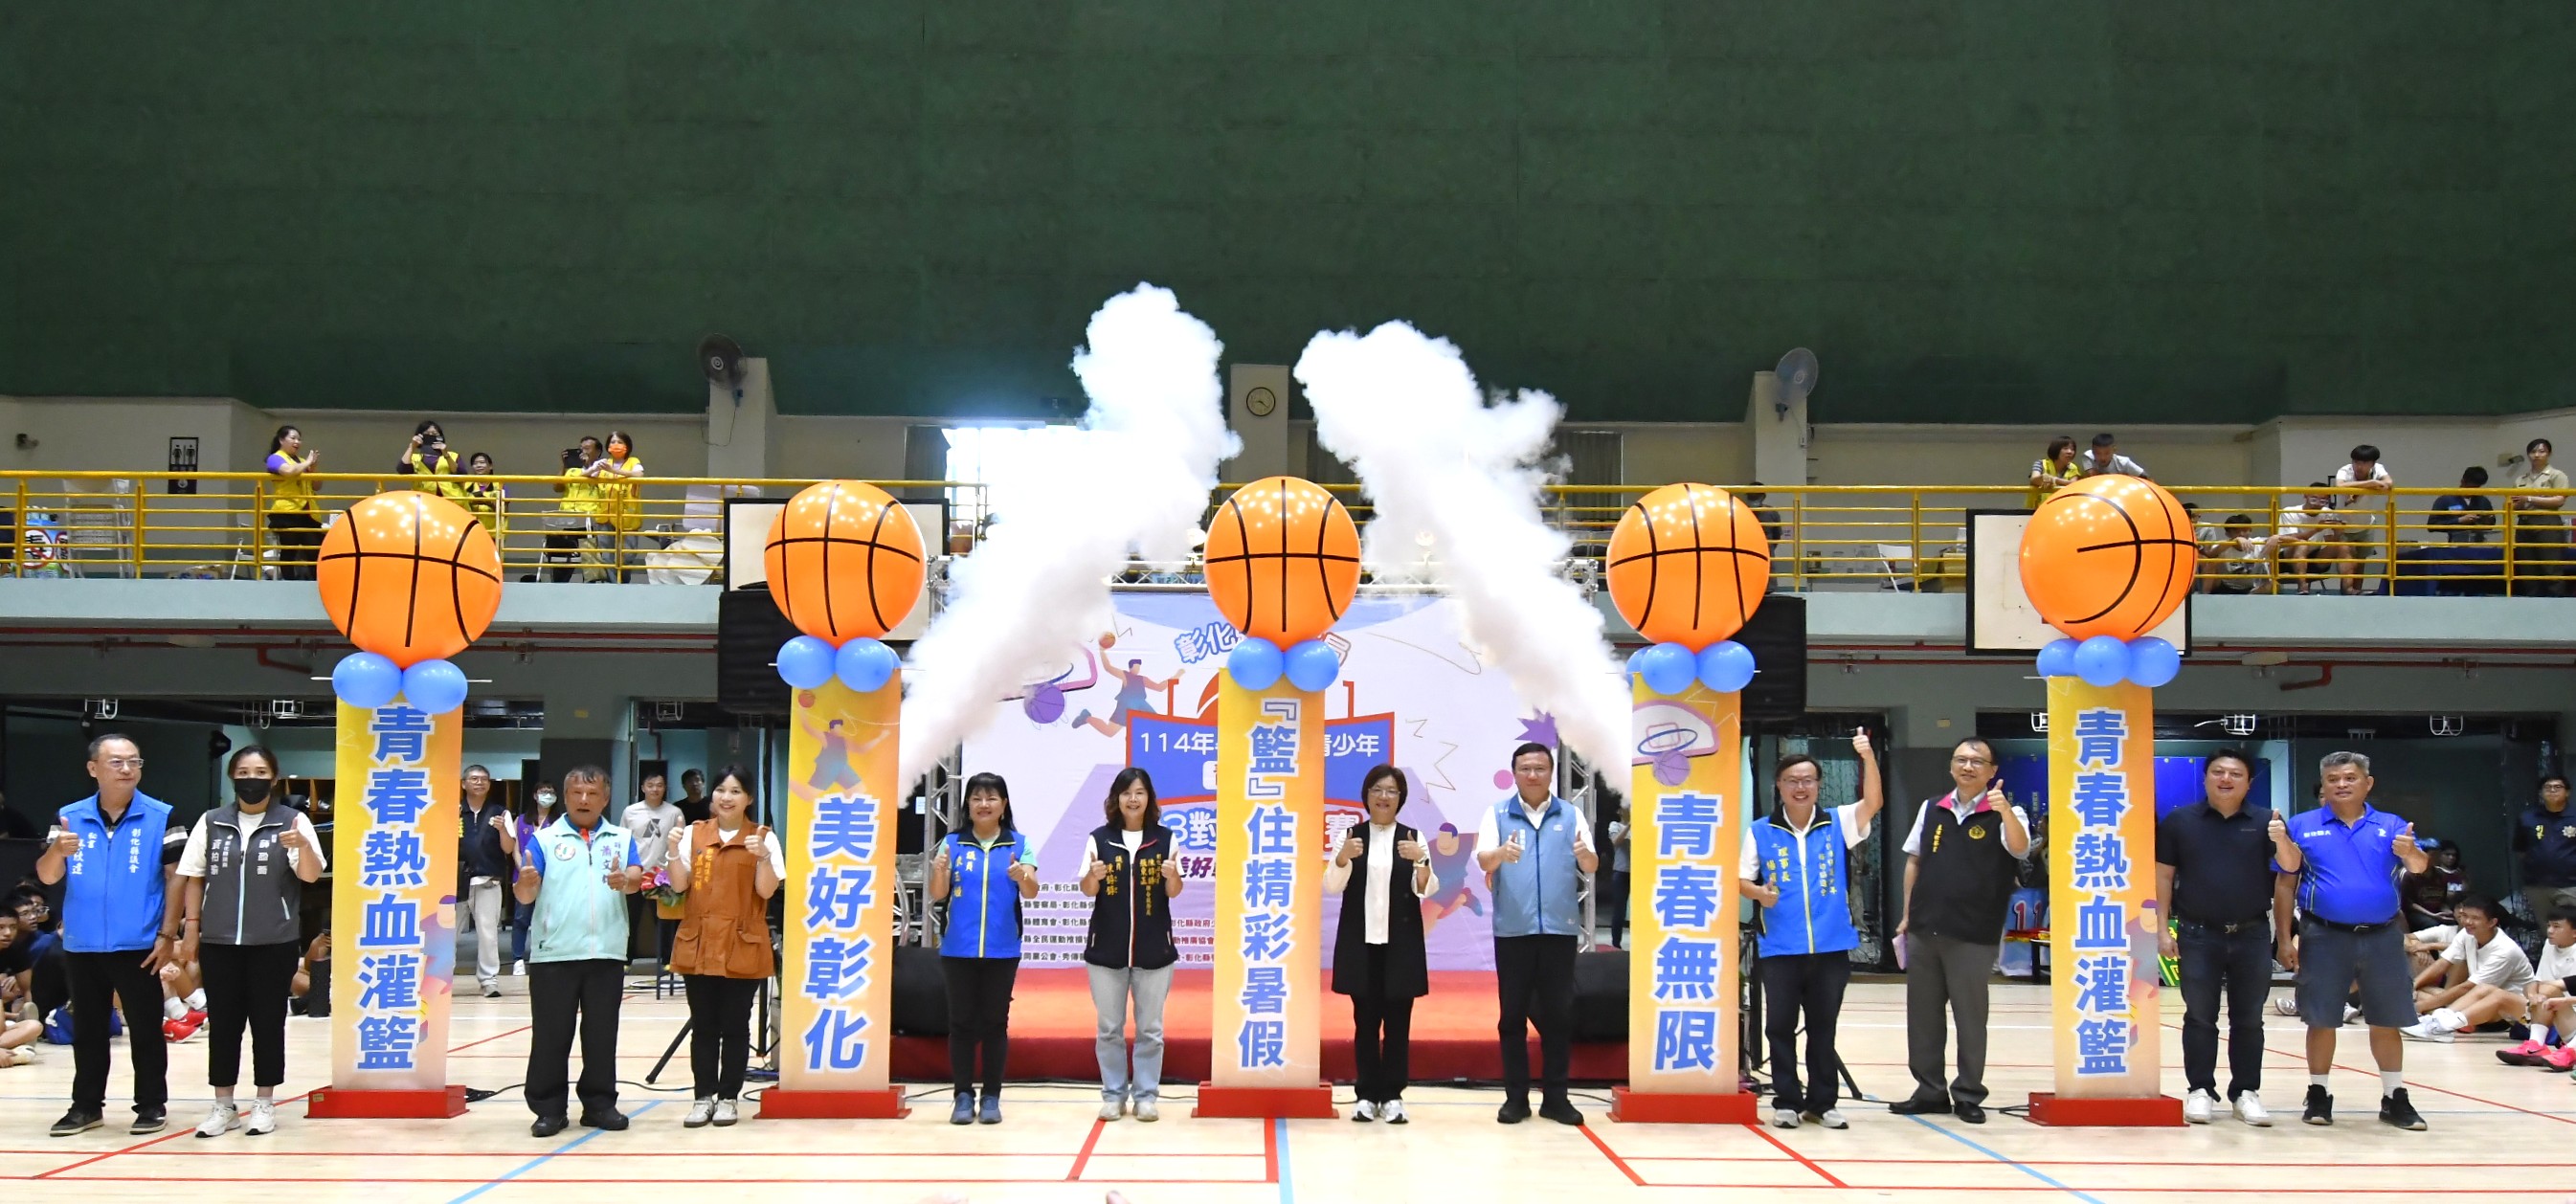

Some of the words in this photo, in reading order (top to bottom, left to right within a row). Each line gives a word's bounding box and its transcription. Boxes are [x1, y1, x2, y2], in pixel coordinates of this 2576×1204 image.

[1140, 731, 1217, 754] 114年
[1176, 622, 1244, 663] 彰化
[356, 705, 431, 1070] 青春熱血灌籃
[804, 796, 876, 1070] 美好彰化
[1237, 701, 1299, 1069] 『籃』住精彩暑假
[1654, 793, 1719, 1071] 青春無限
[2073, 710, 2128, 1075] 青春熱血灌籃
